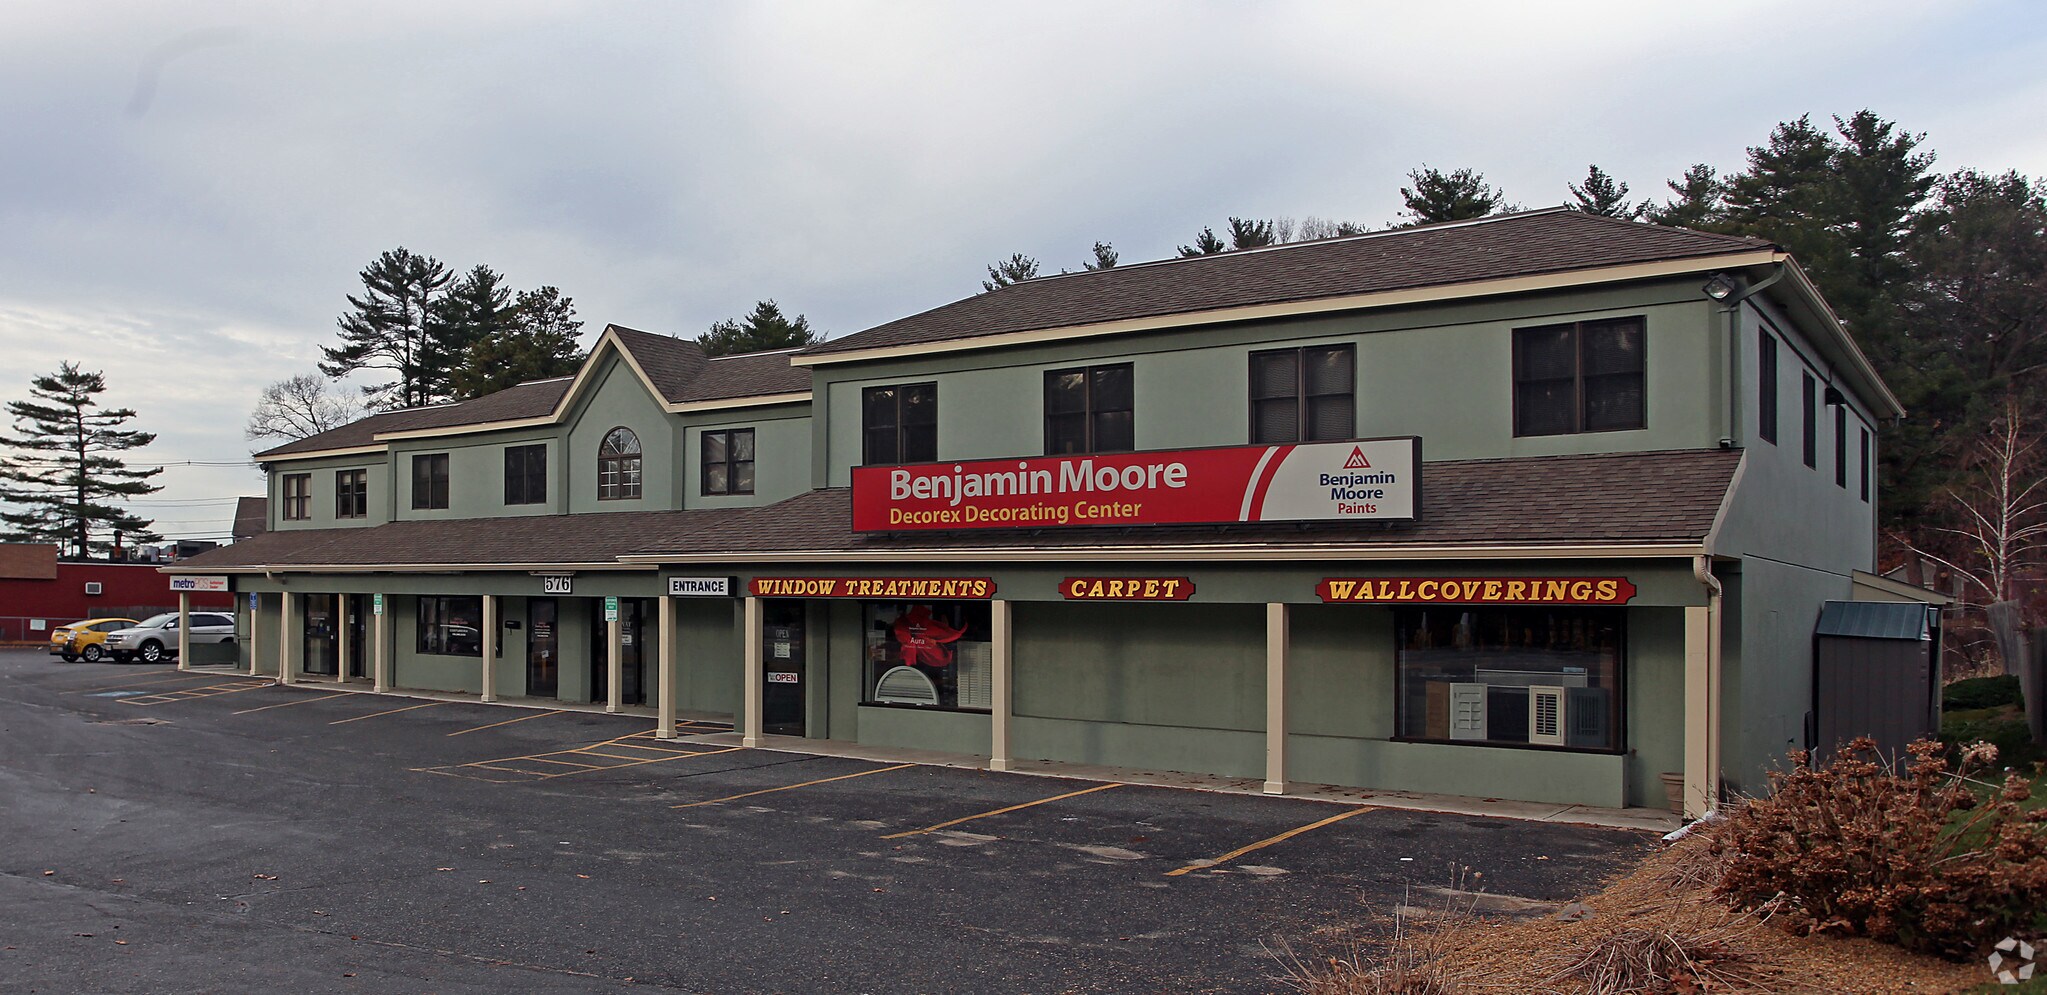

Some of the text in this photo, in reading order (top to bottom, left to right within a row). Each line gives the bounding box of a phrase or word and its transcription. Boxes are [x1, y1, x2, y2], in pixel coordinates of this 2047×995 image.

[890, 459, 1188, 507] Benjamin Moore
[1319, 470, 1395, 488] Benjamin
[1331, 487, 1384, 500] Moore
[889, 500, 1142, 525] Decorex Decorating Center
[1338, 502, 1377, 514] Paints
[173, 578, 208, 589] metroPCS
[545, 577, 570, 591] 576
[672, 580, 725, 592] ENTRANCE
[757, 579, 988, 597] WINDOW TREATMENTS
[1070, 579, 1180, 598] CARPET
[1328, 580, 1618, 601] WALLCOVERINGS
[910, 637, 925, 645] Aura
[775, 673, 797, 682] OPEN
